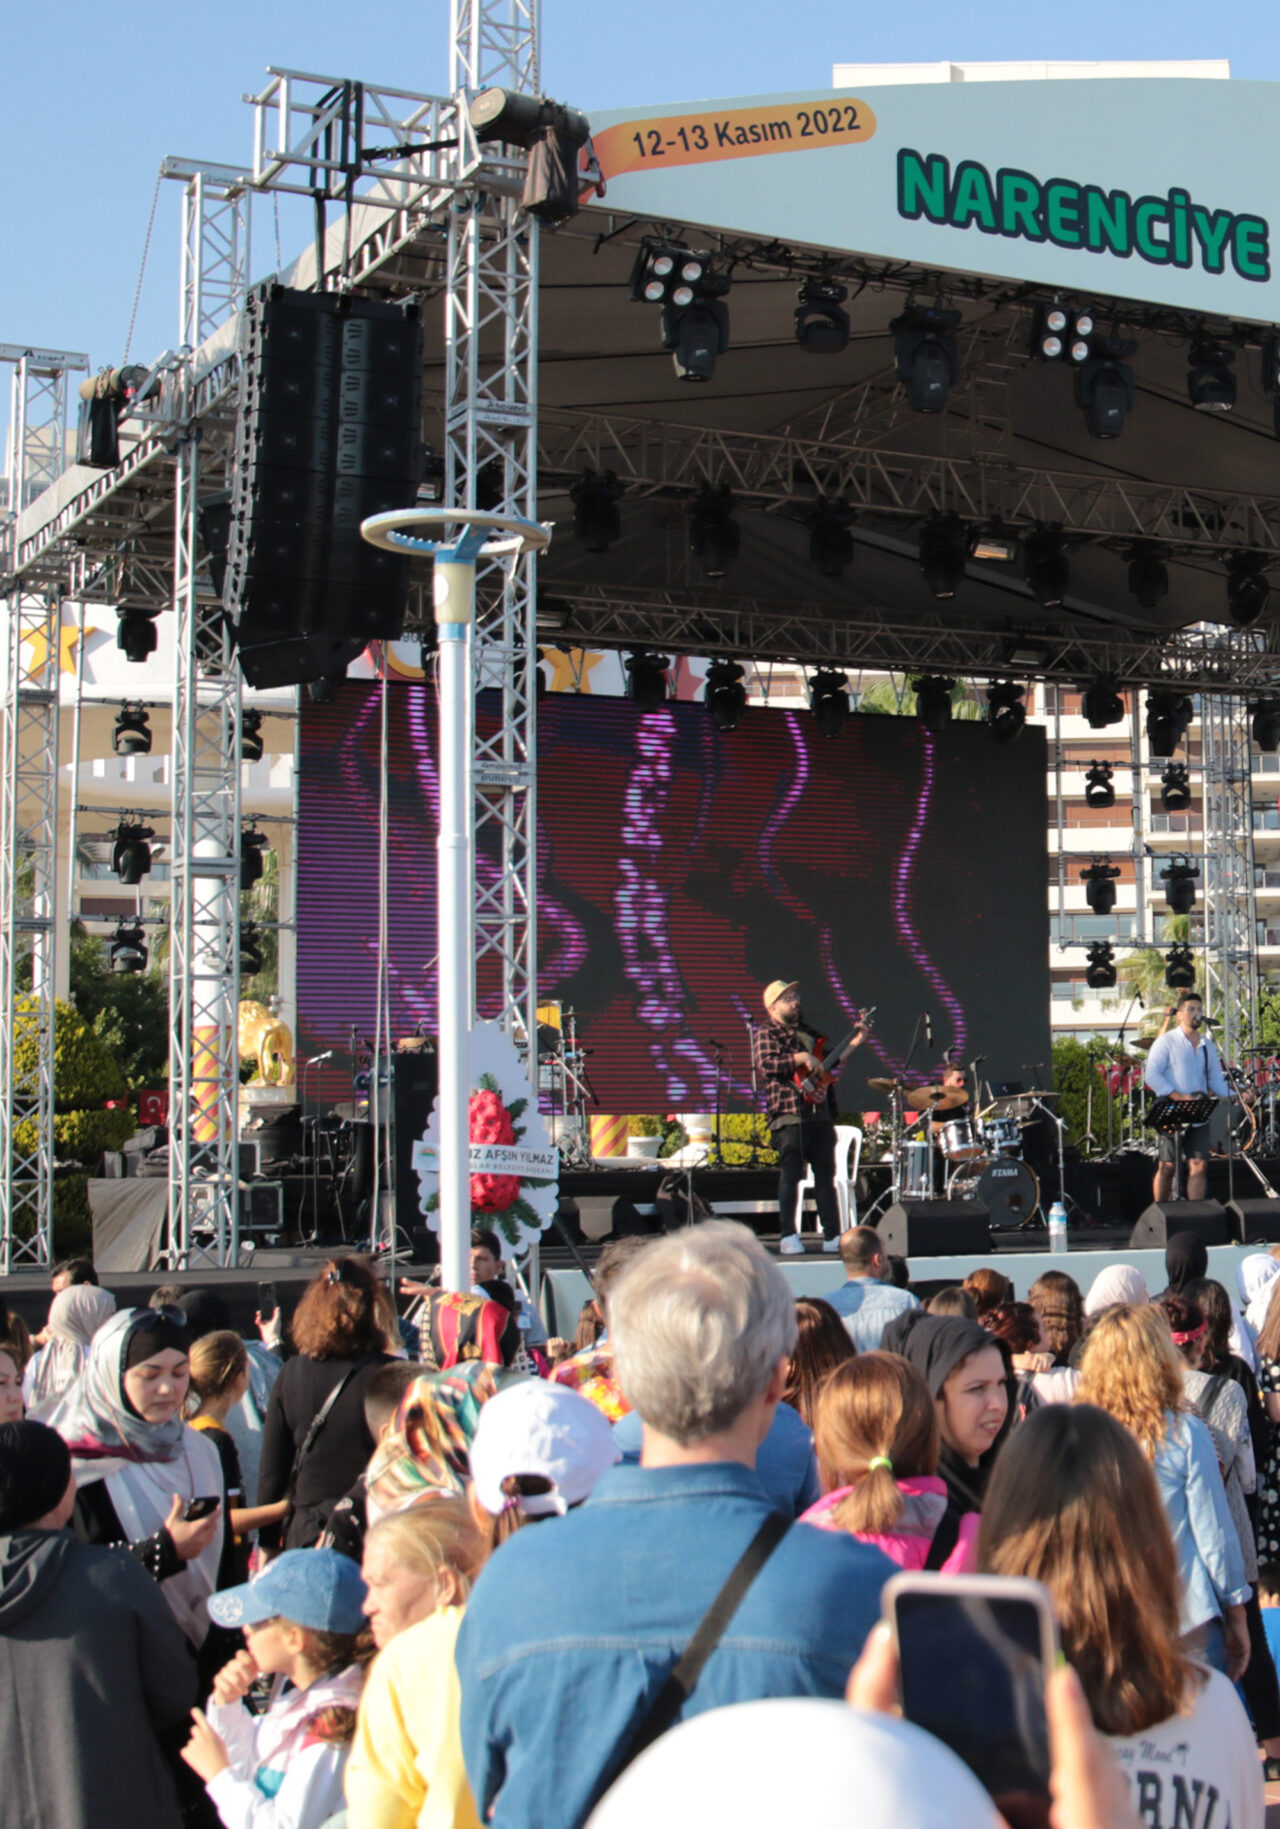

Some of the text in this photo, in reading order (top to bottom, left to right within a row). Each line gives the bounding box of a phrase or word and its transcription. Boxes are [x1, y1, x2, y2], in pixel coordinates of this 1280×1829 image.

[633, 105, 861, 157] 12-13 Kasım 2022
[897, 148, 1271, 282] NARENCİYE
[520, 1152, 554, 1165] YILMAZ
